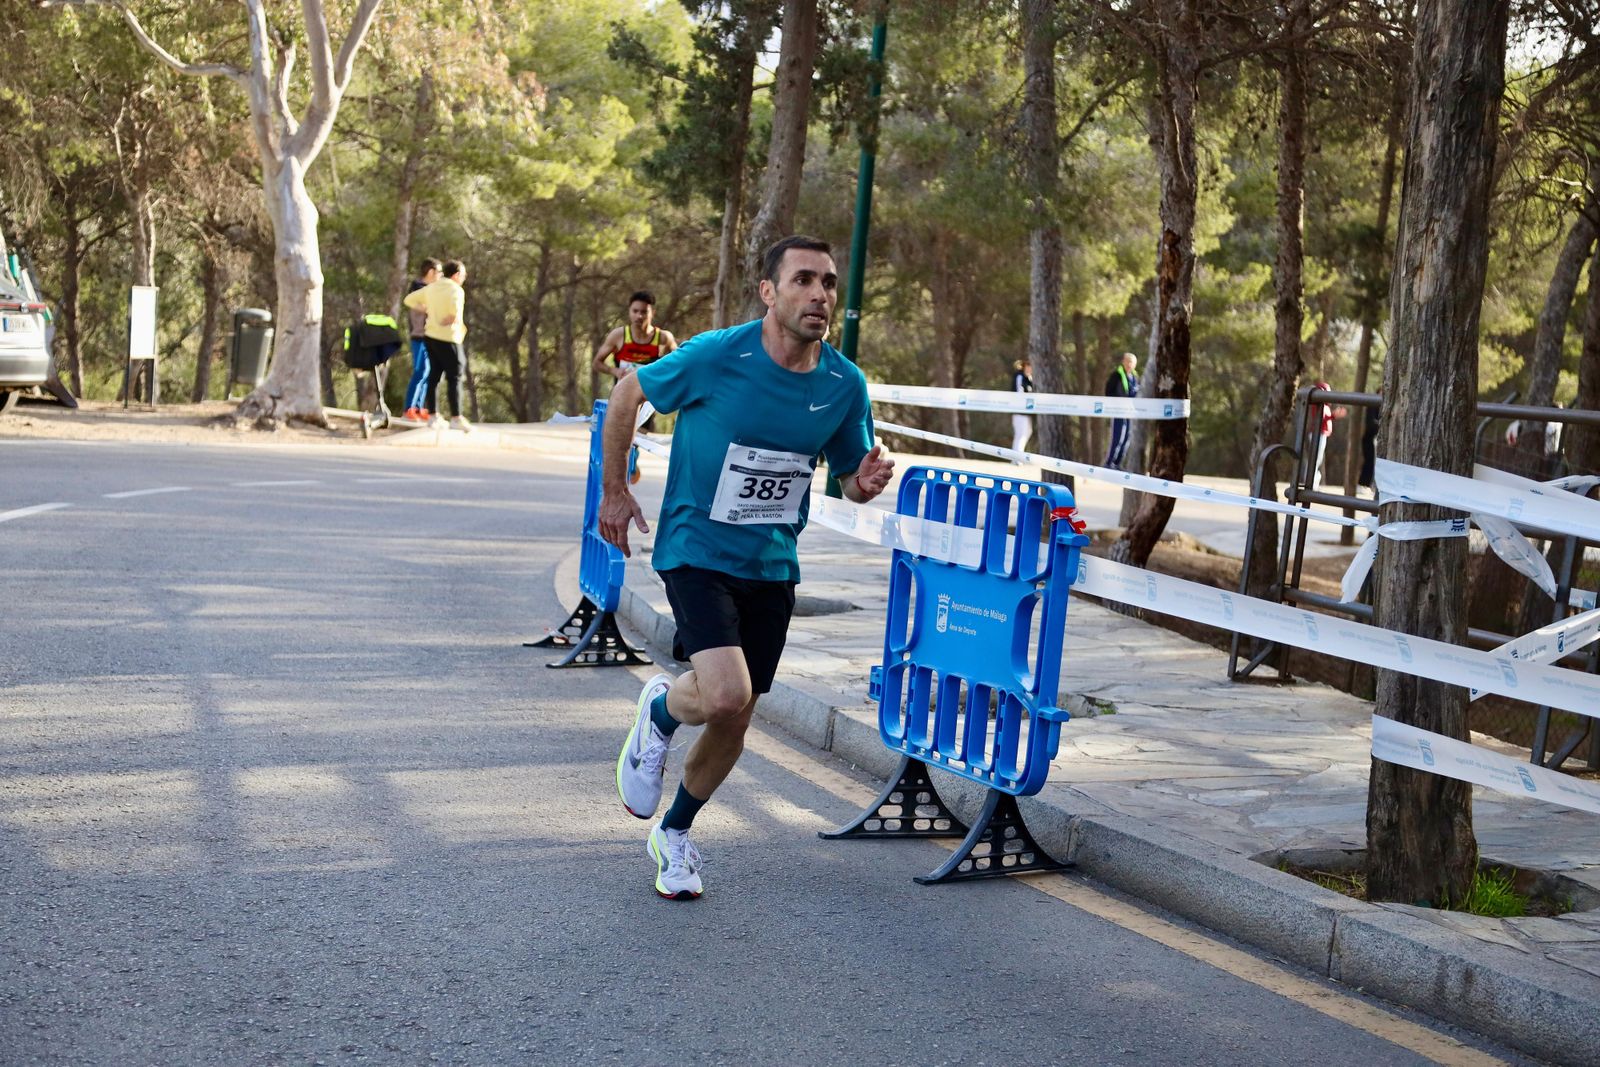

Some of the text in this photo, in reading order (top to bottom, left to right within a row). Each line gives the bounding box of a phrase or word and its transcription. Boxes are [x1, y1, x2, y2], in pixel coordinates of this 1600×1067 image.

[739, 477, 791, 500] 385
[951, 601, 1007, 622] Ayuntamiento de Málaga
